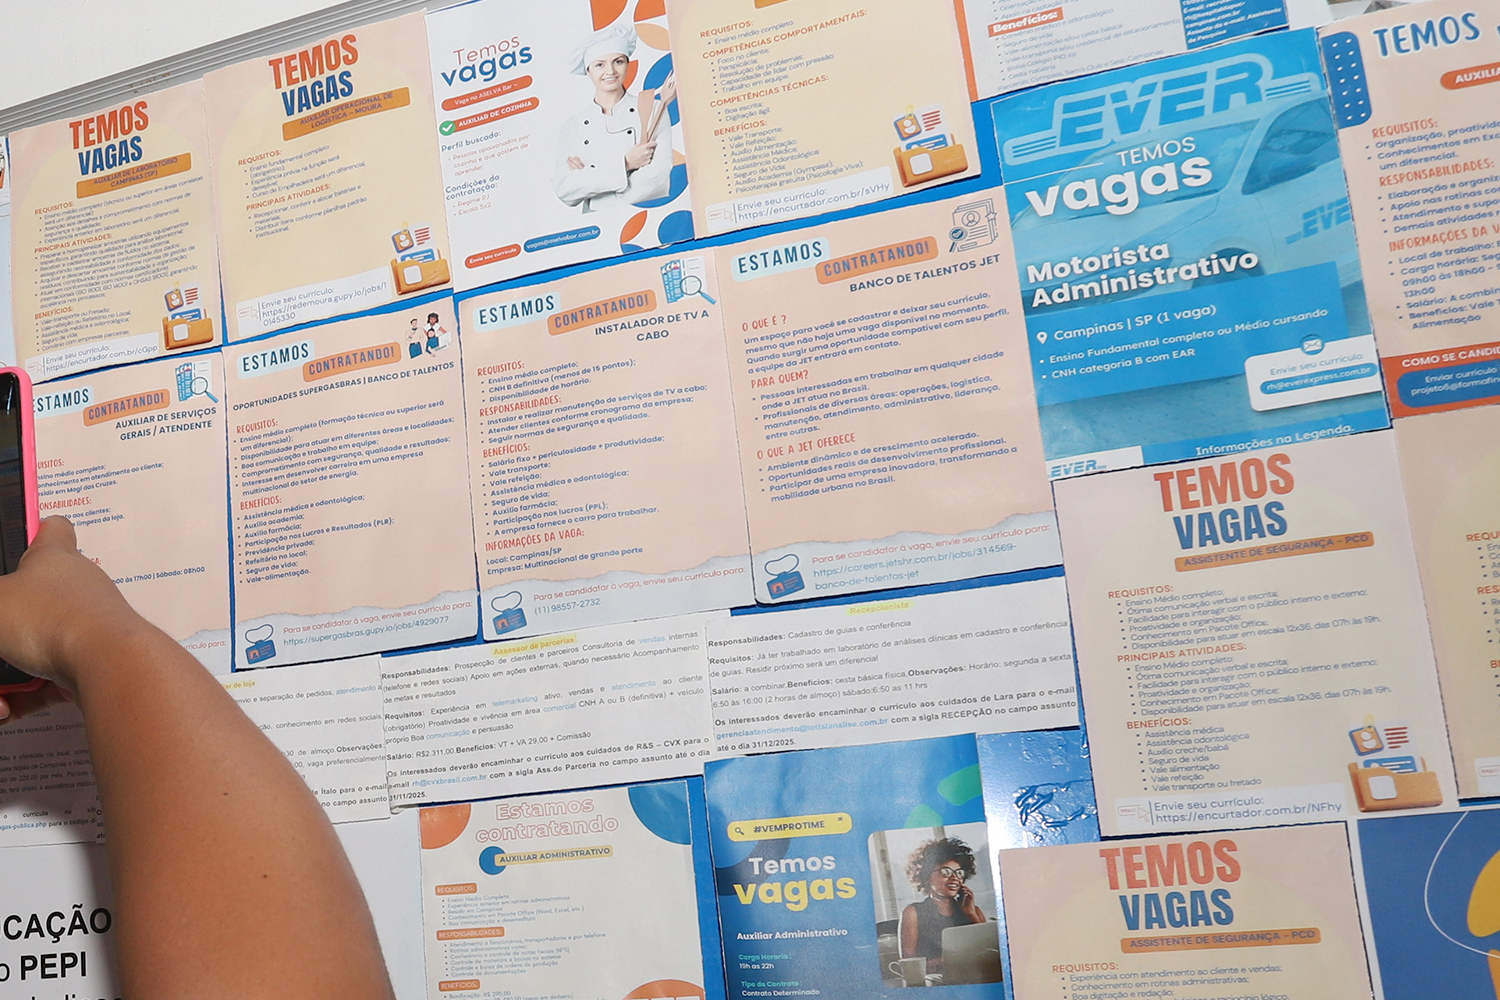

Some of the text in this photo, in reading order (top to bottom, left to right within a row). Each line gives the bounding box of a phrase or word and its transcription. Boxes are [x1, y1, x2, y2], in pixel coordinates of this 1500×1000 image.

[453, 35, 521, 64] Temos
[1374, 13, 1480, 58] TEMOS
[268, 34, 359, 90] TEMOS
[440, 44, 533, 87] vagas
[281, 71, 354, 116] VAGAS
[709, 74, 829, 108] COMPETÊNCIAS TÉCNICAS:
[1056, 59, 1264, 148] EVER
[69, 101, 149, 150] TEMOS
[78, 136, 143, 176] VAGAS
[1116, 136, 1196, 168] TEMOS
[1025, 157, 1213, 218] vagas
[737, 241, 823, 274] ESTAMOS
[823, 241, 930, 277] CONTRATANDO!
[850, 254, 1001, 293] BANCO DE TALENTOS JET
[1026, 240, 1170, 284] Motorista
[1031, 251, 1260, 308] Administrativo
[479, 295, 555, 325] ESTAMOS
[554, 294, 649, 328] CONTRATANDO!
[595, 310, 709, 336] INSTALADOR DE TV A
[1054, 320, 1125, 343] Campinas
[1135, 314, 1153, 328] SP
[1157, 311, 1170, 326] (1
[1174, 304, 1217, 322] vaga)
[636, 329, 669, 342] CABO
[243, 343, 309, 372] ESTAMOS
[308, 348, 396, 376] CONTRATANDO!
[233, 391, 298, 411] OPORTUNIDADES
[299, 378, 362, 398] SUPERGASBRAS
[367, 372, 399, 384] BANCO
[400, 369, 413, 379] DE
[414, 361, 455, 378] TALENTOS
[88, 392, 164, 420] CONTRATANDO!
[115, 407, 217, 429] AUXILIAR DE SERVIÇOS
[120, 428, 150, 441] GERAIS
[159, 420, 212, 435] ATENDENTE
[1195, 423, 1355, 457] Informações na Legenda.
[1153, 453, 1294, 512] TEMOS
[1173, 501, 1288, 550] VAGAS
[1184, 552, 1247, 566] ASSISTENTE
[1249, 549, 1264, 559] DE
[1266, 539, 1334, 556] SEGURANÇA
[1345, 534, 1368, 544] PCD
[495, 799, 595, 821] Estamos
[753, 819, 825, 834] #VEMPROTIME
[475, 815, 619, 843] contratando
[500, 846, 611, 865] AUXILIAR ADMINISTRATIVO
[748, 855, 836, 876] Temos
[1099, 839, 1241, 891] TEMOS
[733, 875, 857, 912] vagas
[1119, 888, 1234, 931] VAGAS
[737, 927, 848, 940] Auxiliar Administrativo
[19, 952, 88, 980] PEPI
